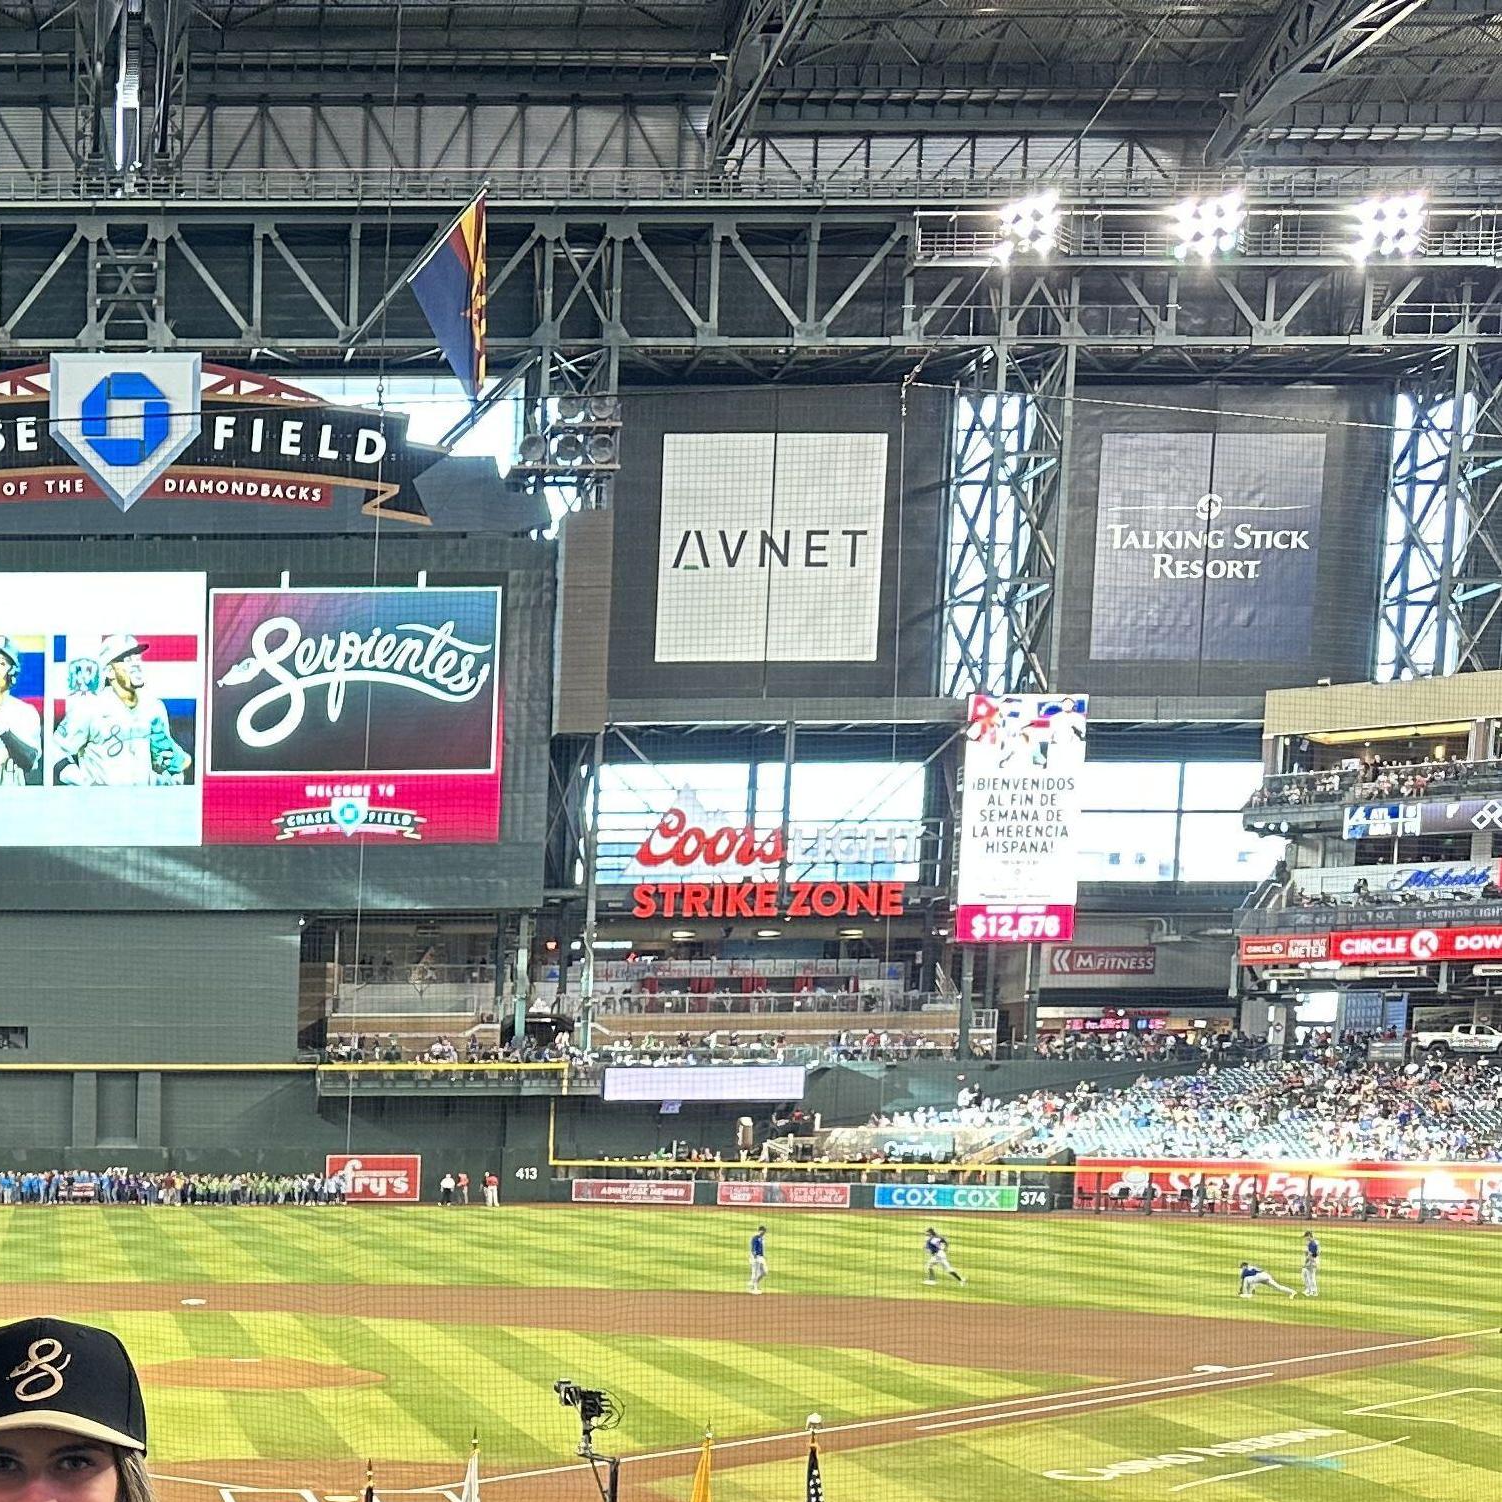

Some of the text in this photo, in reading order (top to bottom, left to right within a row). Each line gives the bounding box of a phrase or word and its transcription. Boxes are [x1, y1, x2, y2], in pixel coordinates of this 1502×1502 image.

[213, 415, 387, 465] FIELD
[2, 481, 29, 496] OF
[45, 478, 85, 494] THE
[163, 477, 323, 502] DIAMONDBACKS
[1108, 521, 1311, 553] TALKING STICK
[671, 527, 870, 569] AVNET
[217, 616, 493, 748] Serpientes
[305, 784, 396, 797] WELCOME TO
[972, 777, 1075, 791] ¡BIENVENIDOS
[987, 793, 1057, 807] AL FIN DE
[286, 812, 413, 827] CHASE FIELD
[979, 809, 1063, 822] SEMANA DE
[635, 807, 921, 867] Coors LIGHT
[972, 825, 1069, 838] LA HERENCIA
[985, 840, 1055, 854] HISPANA!
[632, 881, 905, 919] STRIKE ZONE
[1287, 946, 1327, 959] METER
[1340, 936, 1408, 955] CIRCLE
[1076, 953, 1095, 969] M
[1096, 957, 1154, 970] FITNESS
[340, 1159, 410, 1197] fry's
[514, 1166, 539, 1181] 413
[891, 1187, 1001, 1208] COX COX
[1020, 1191, 1047, 1207] 374
